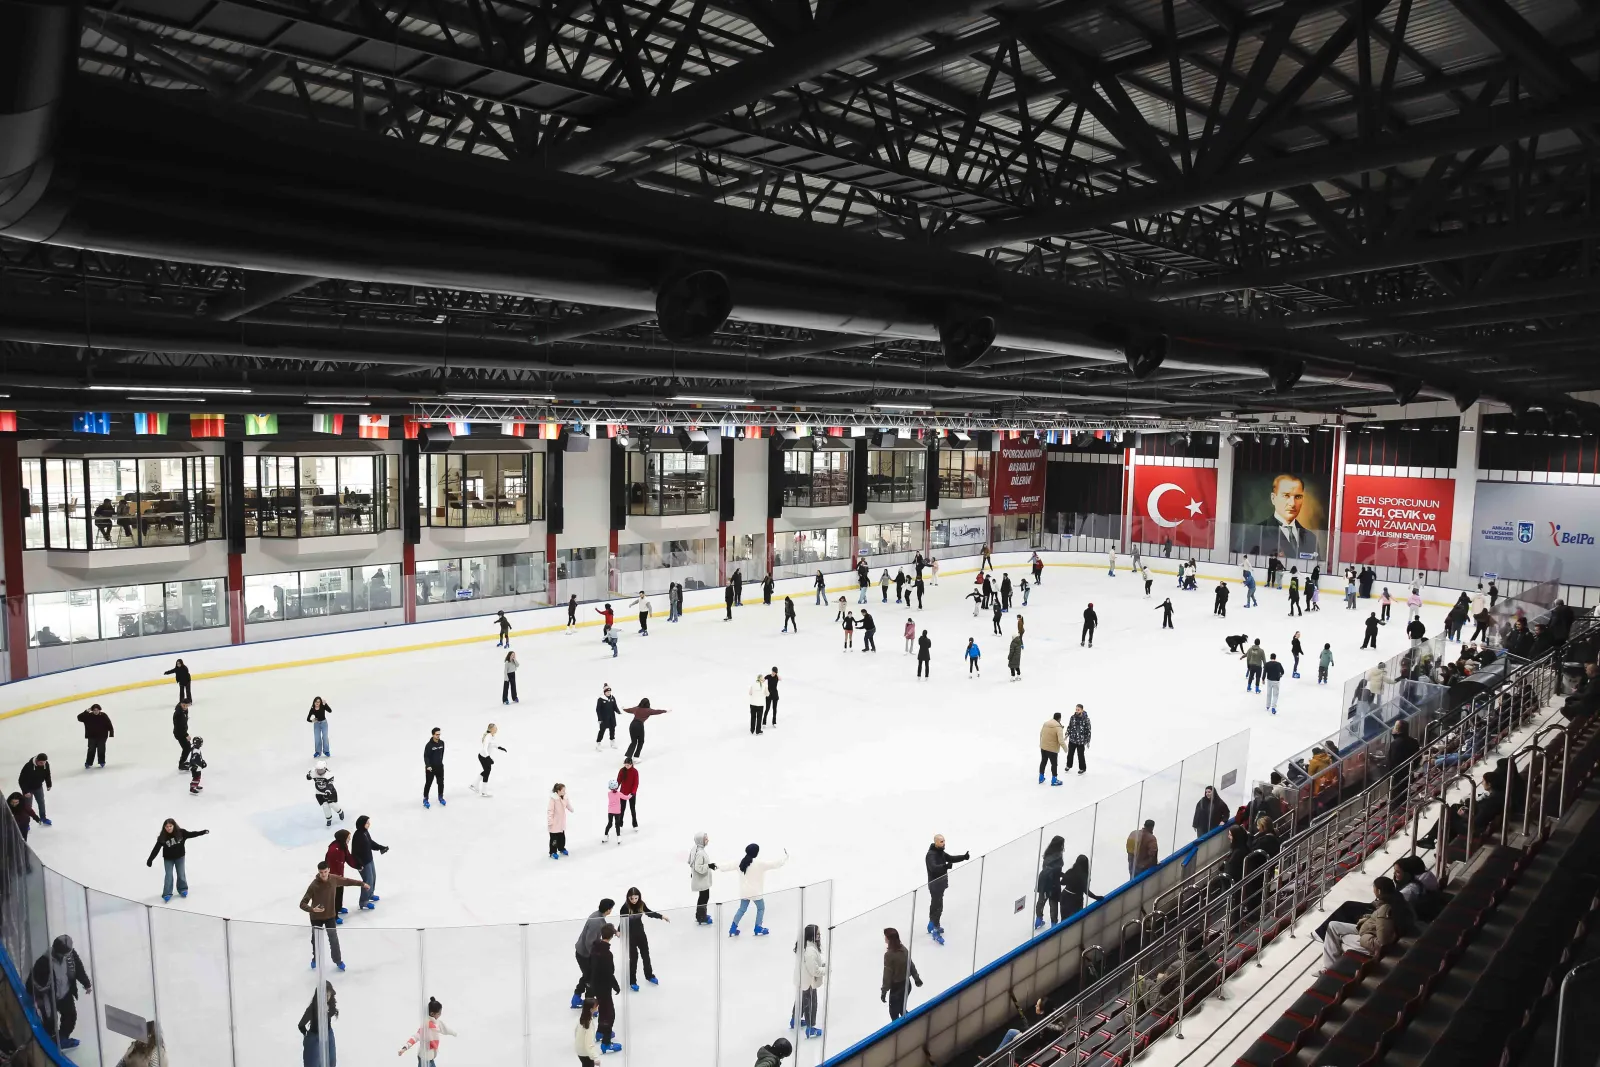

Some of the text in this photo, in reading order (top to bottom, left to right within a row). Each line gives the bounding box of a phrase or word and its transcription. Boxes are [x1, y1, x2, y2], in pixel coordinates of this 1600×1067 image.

[1357, 496, 1440, 508] BEN SPORCUNUN
[1423, 513, 1436, 521] ve
[1356, 519, 1437, 533] AYNI ZAMANDA
[1561, 532, 1595, 545] BelPa
